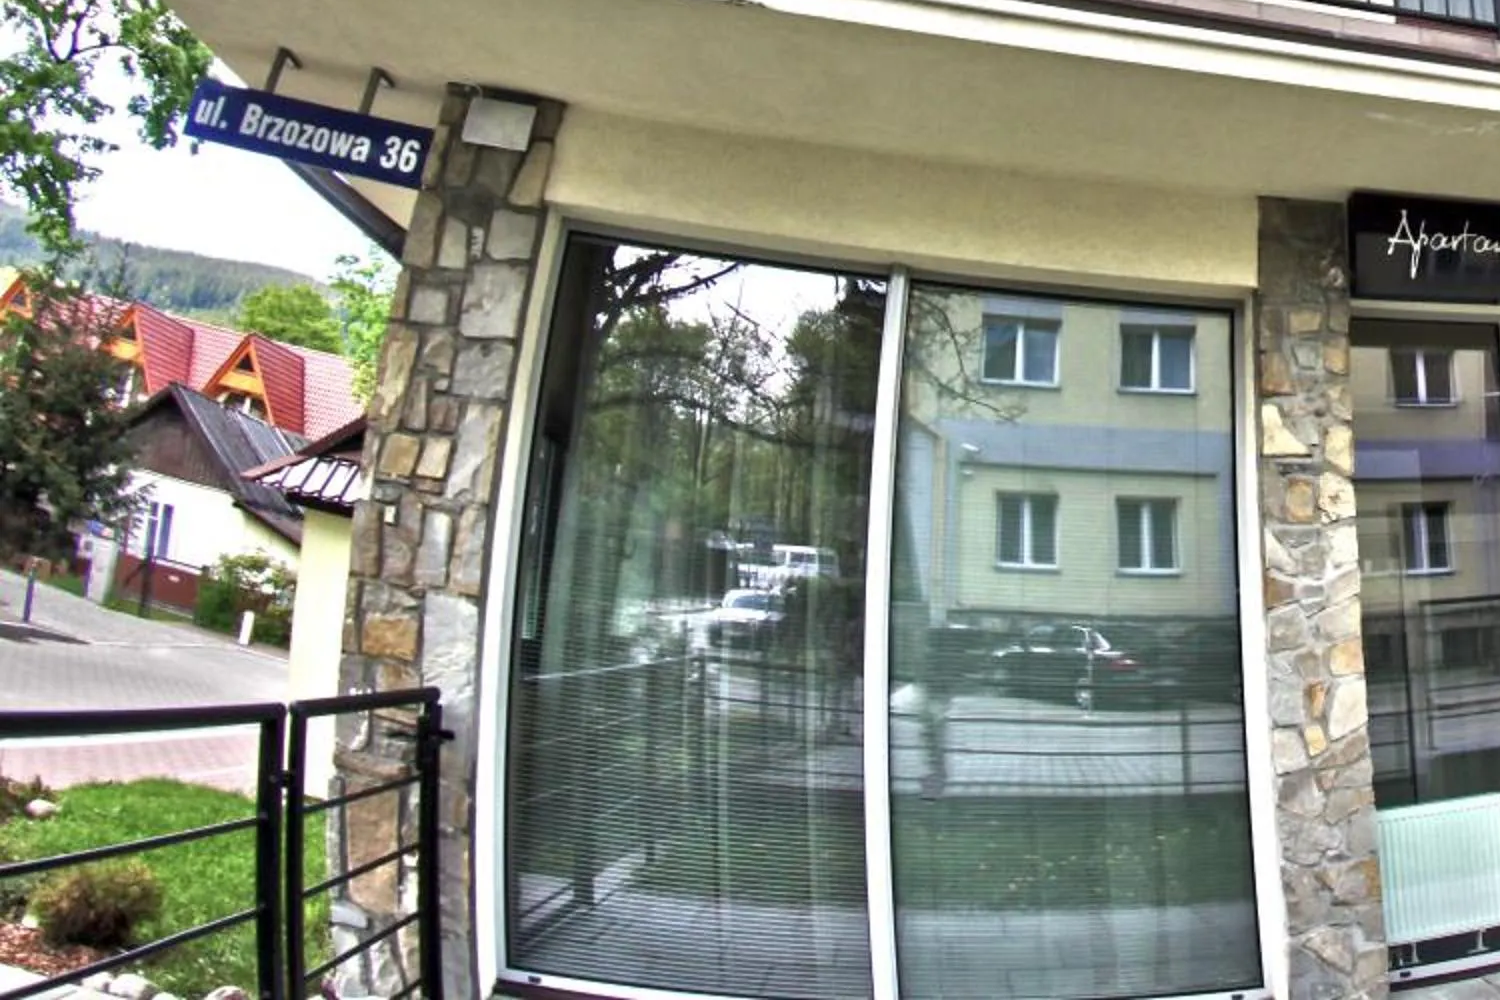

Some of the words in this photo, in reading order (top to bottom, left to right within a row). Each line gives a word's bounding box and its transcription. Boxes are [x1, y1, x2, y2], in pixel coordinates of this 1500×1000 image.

[194, 96, 228, 130] ul.
[239, 103, 371, 163] Brzozowa
[379, 135, 421, 173] 36
